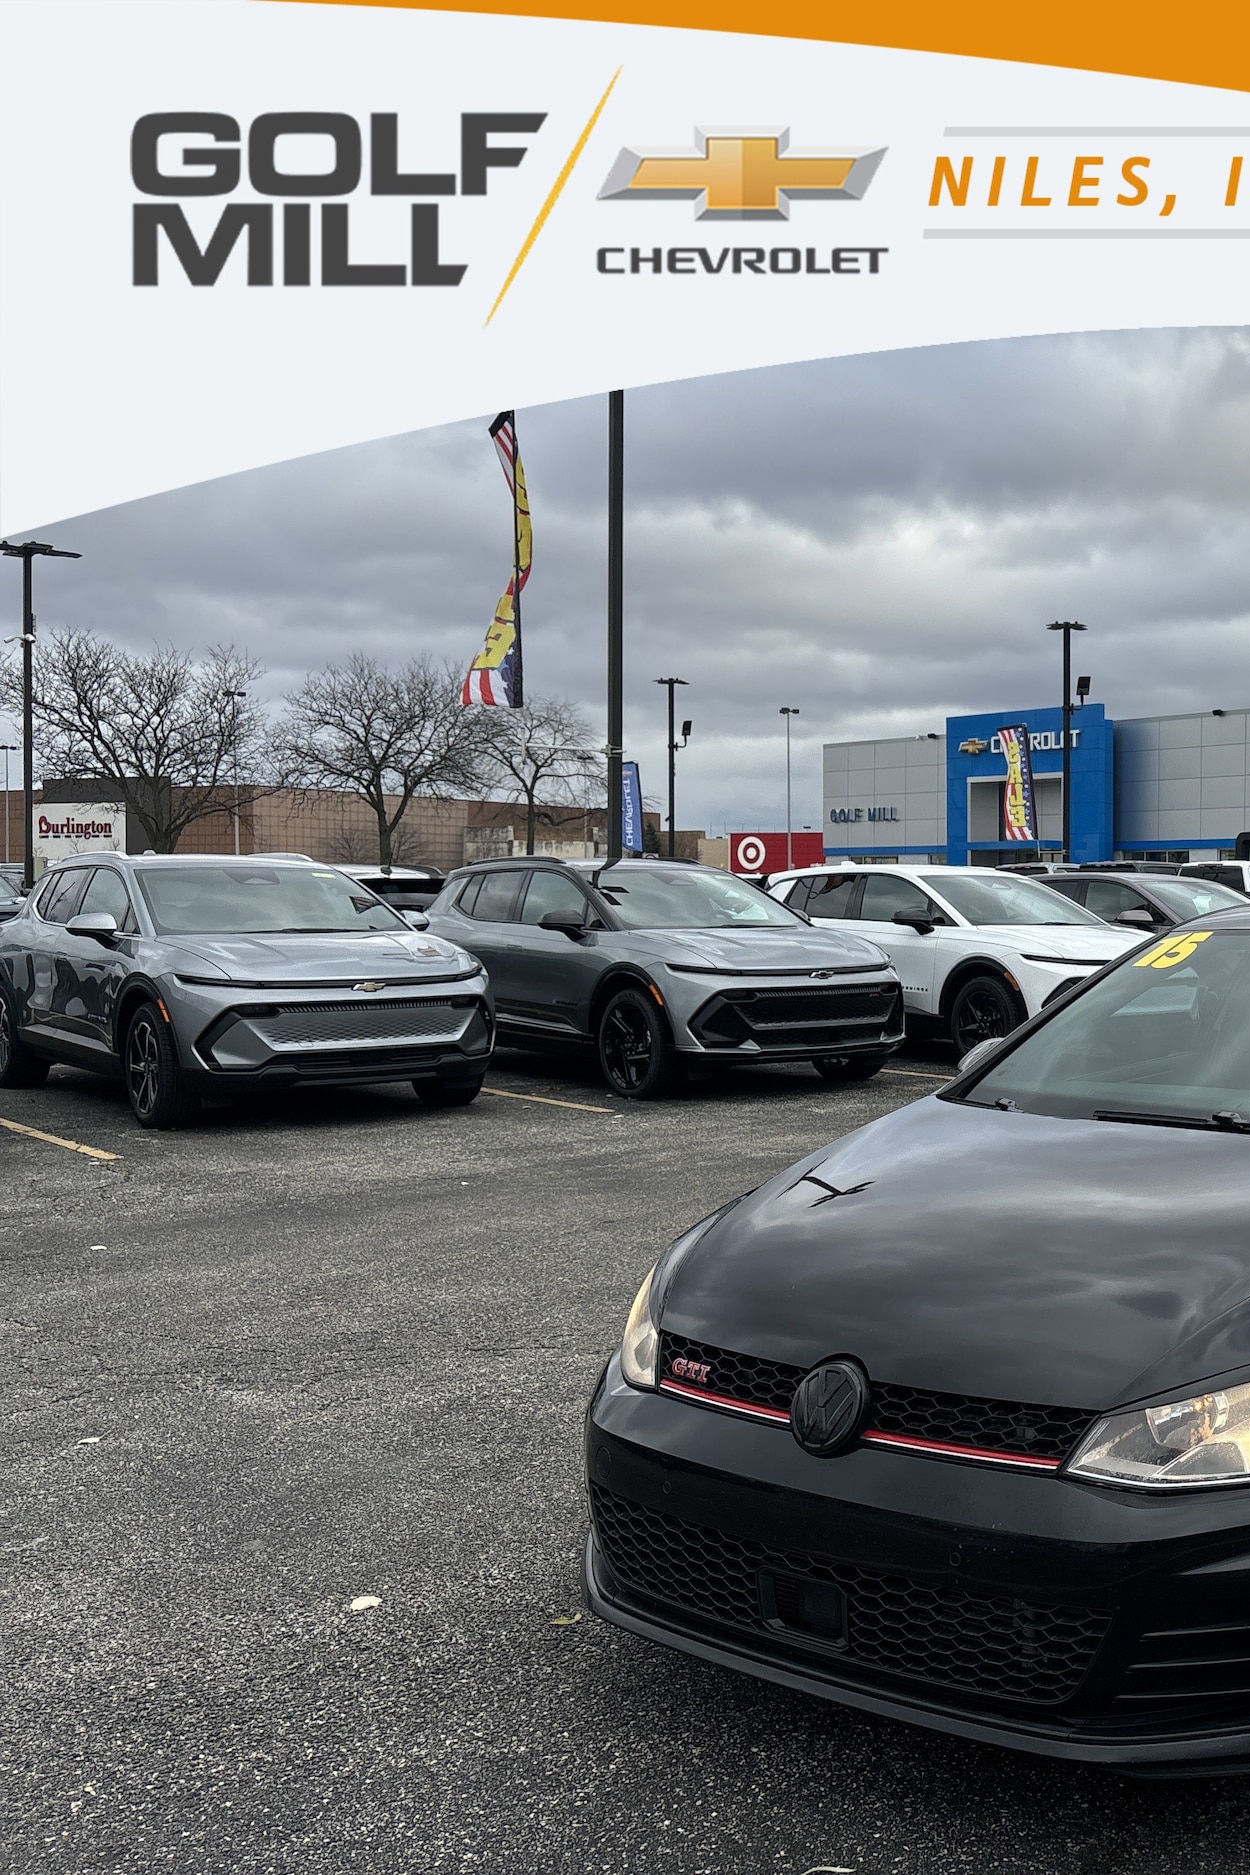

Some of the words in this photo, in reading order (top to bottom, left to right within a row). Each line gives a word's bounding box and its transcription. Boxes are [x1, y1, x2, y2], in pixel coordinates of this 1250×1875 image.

[990, 729, 1080, 754] CROLT
[38, 815, 112, 840] Burlington
[830, 808, 863, 824] GOLF
[867, 806, 898, 822] MILL
[1132, 931, 1215, 969] 15
[671, 1357, 712, 1384] GTI
